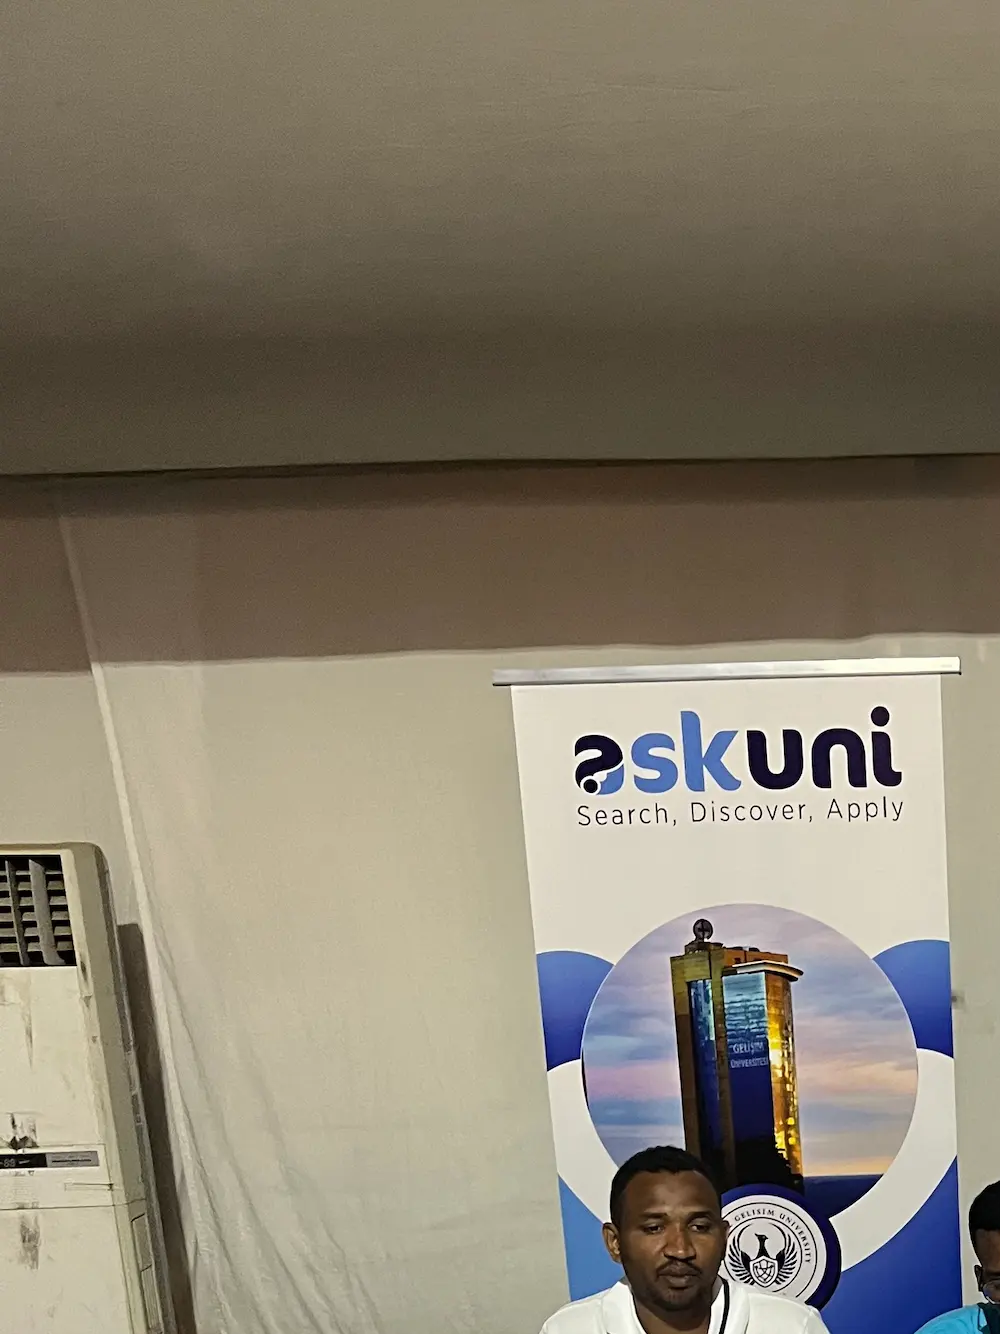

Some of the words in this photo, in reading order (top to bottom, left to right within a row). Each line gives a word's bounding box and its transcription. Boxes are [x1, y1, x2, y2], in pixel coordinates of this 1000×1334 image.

[574, 705, 903, 796] askuni
[577, 802, 677, 827] Search,
[690, 800, 814, 823] Discover,
[827, 796, 905, 823] Apply
